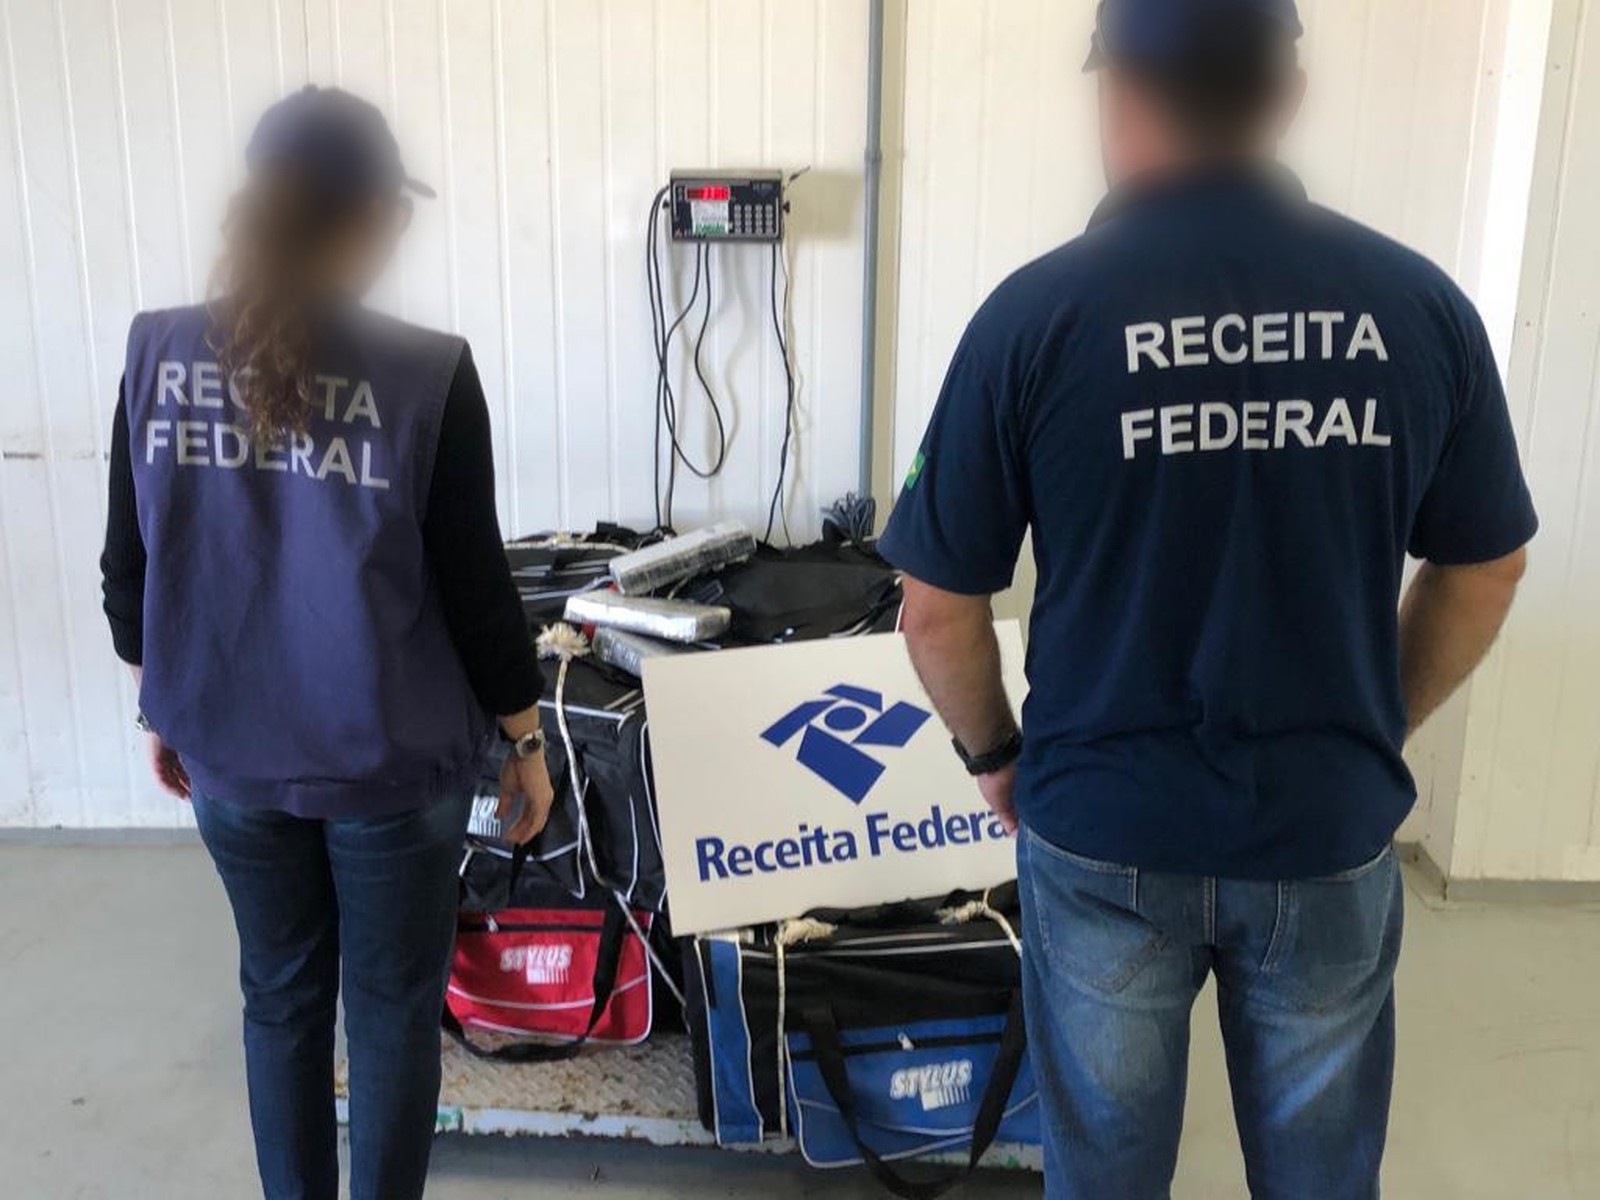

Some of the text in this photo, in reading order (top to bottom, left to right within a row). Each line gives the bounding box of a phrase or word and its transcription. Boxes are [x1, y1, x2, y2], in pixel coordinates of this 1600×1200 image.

[1124, 311, 1389, 373] RECEITA
[157, 361, 382, 428] RECTA
[146, 420, 390, 489] FEDERAL
[1121, 398, 1392, 460] FEDERAL
[695, 805, 1011, 882] Receita Federa
[500, 944, 573, 973] STYLUS
[890, 1059, 973, 1100] STYLUS
